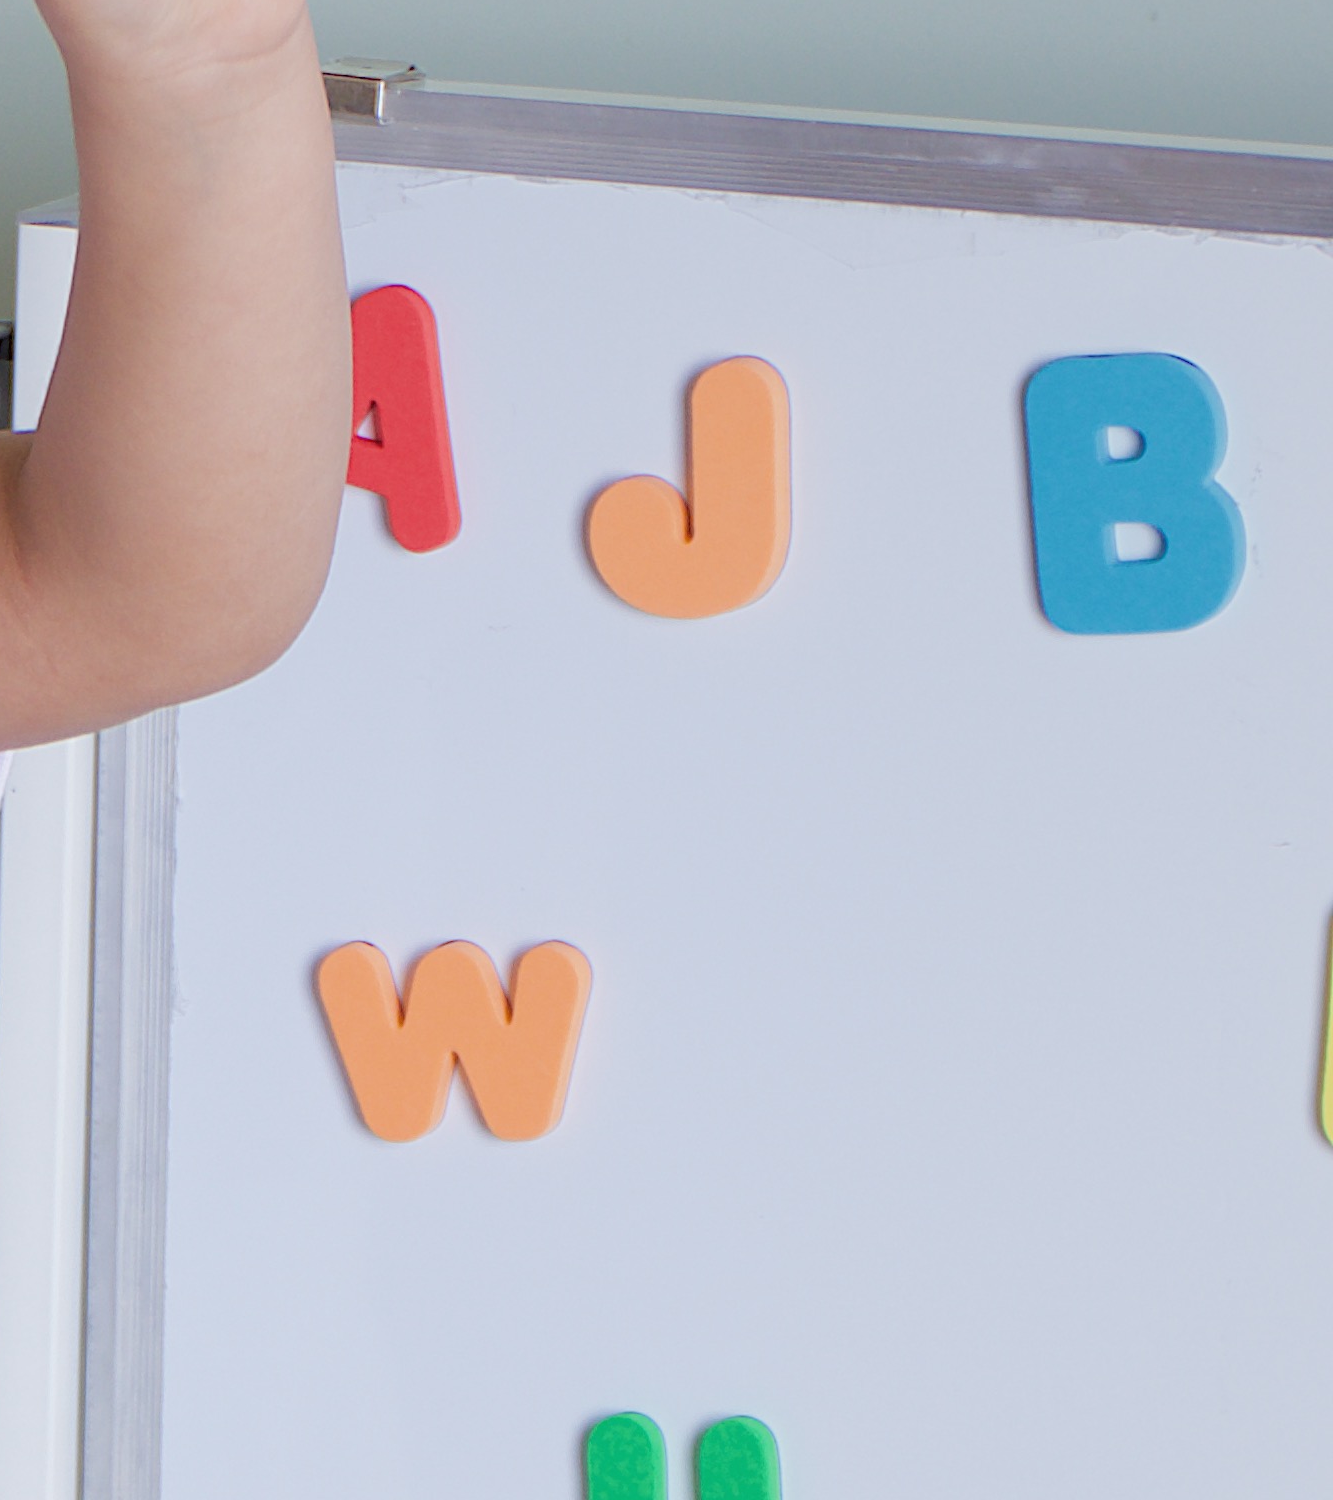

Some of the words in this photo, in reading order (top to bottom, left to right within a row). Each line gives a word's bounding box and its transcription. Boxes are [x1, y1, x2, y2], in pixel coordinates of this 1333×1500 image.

[345, 284, 462, 554] A
[585, 357, 792, 620] J
[1023, 351, 1248, 636] B
[317, 940, 593, 1143] W
